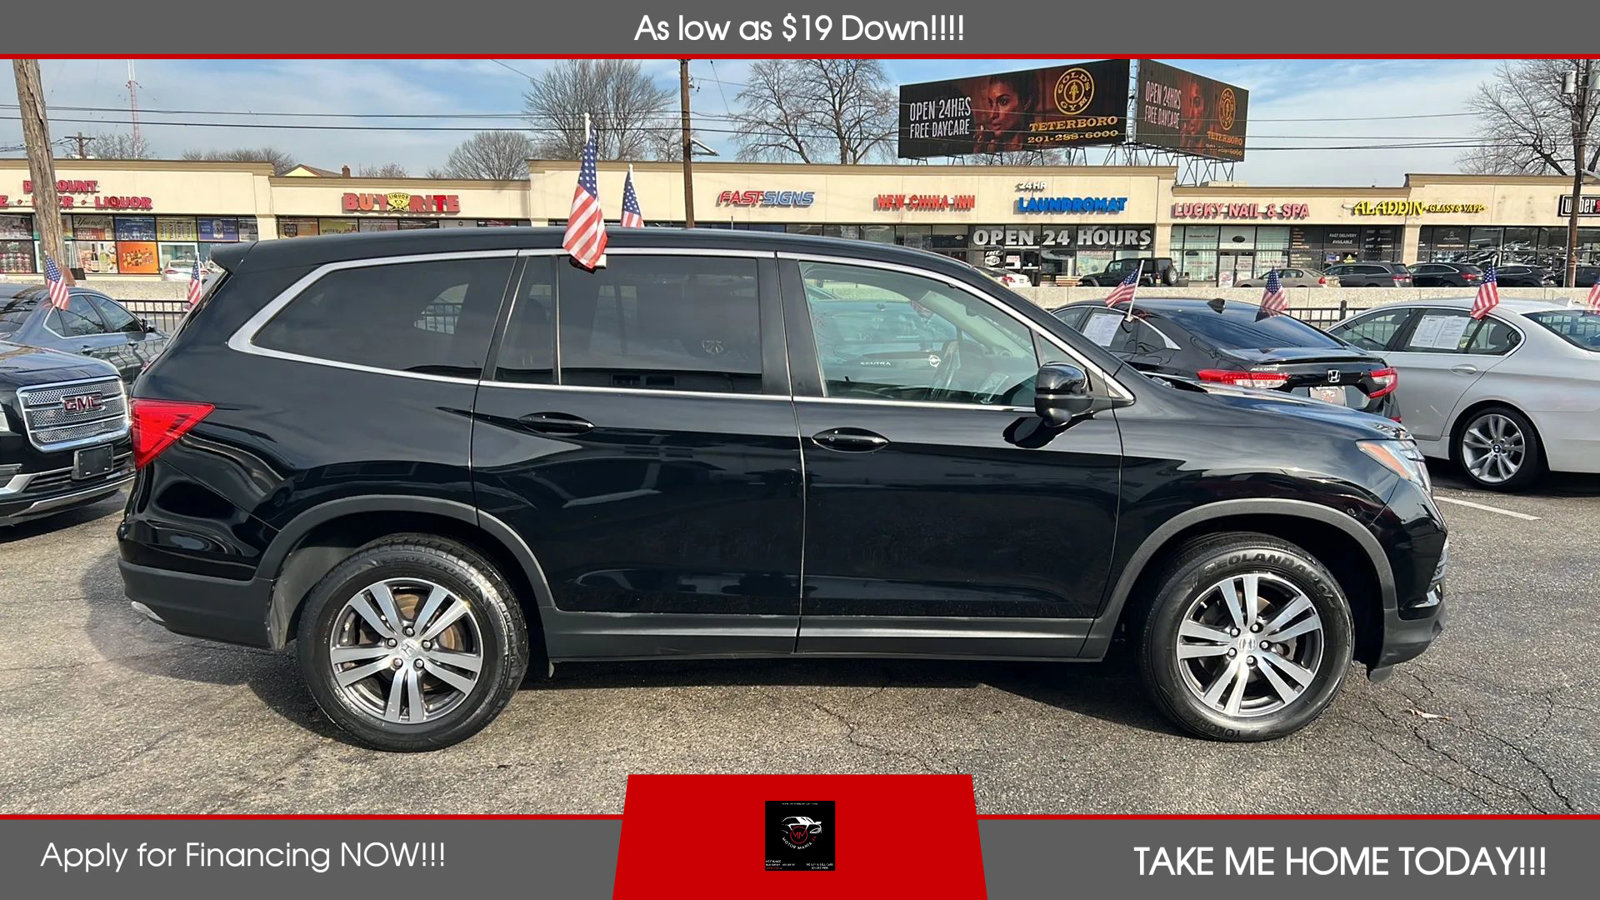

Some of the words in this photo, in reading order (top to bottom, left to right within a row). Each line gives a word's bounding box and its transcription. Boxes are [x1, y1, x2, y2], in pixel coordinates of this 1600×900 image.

[1057, 71, 1091, 94] GOLD'S
[1145, 80, 1163, 105] OPEN
[909, 100, 936, 121] OPEN
[938, 96, 972, 119] 24HRS
[1060, 96, 1088, 112] GYM
[1029, 115, 1118, 132] TETERBORO
[1144, 104, 1158, 125] FREE
[1157, 108, 1181, 130] DAYCARE
[909, 122, 930, 139] FREE
[931, 118, 971, 138] DAYCARE
[23, 180, 98, 194] DOUNT
[94, 196, 153, 211] LIQUOR
[341, 192, 388, 211] BUY
[408, 194, 460, 213] RITE
[718, 190, 815, 207] FASTSIGNS
[876, 194, 906, 209] NEW
[909, 194, 949, 209] CHINA
[953, 194, 976, 209] INN
[1017, 196, 1128, 213] LAUNDROMAT
[1564, 198, 1596, 213] wber
[1174, 202, 1225, 217] LUCKY
[1228, 202, 1264, 217] NAIL
[1266, 203, 1278, 217] &
[1282, 203, 1310, 218] SPA
[1353, 200, 1423, 216] ALADDIN
[973, 229, 1034, 246] OPEN
[1042, 229, 1071, 246] 24
[1077, 229, 1151, 246] HOURS
[63, 393, 103, 412] GMC
